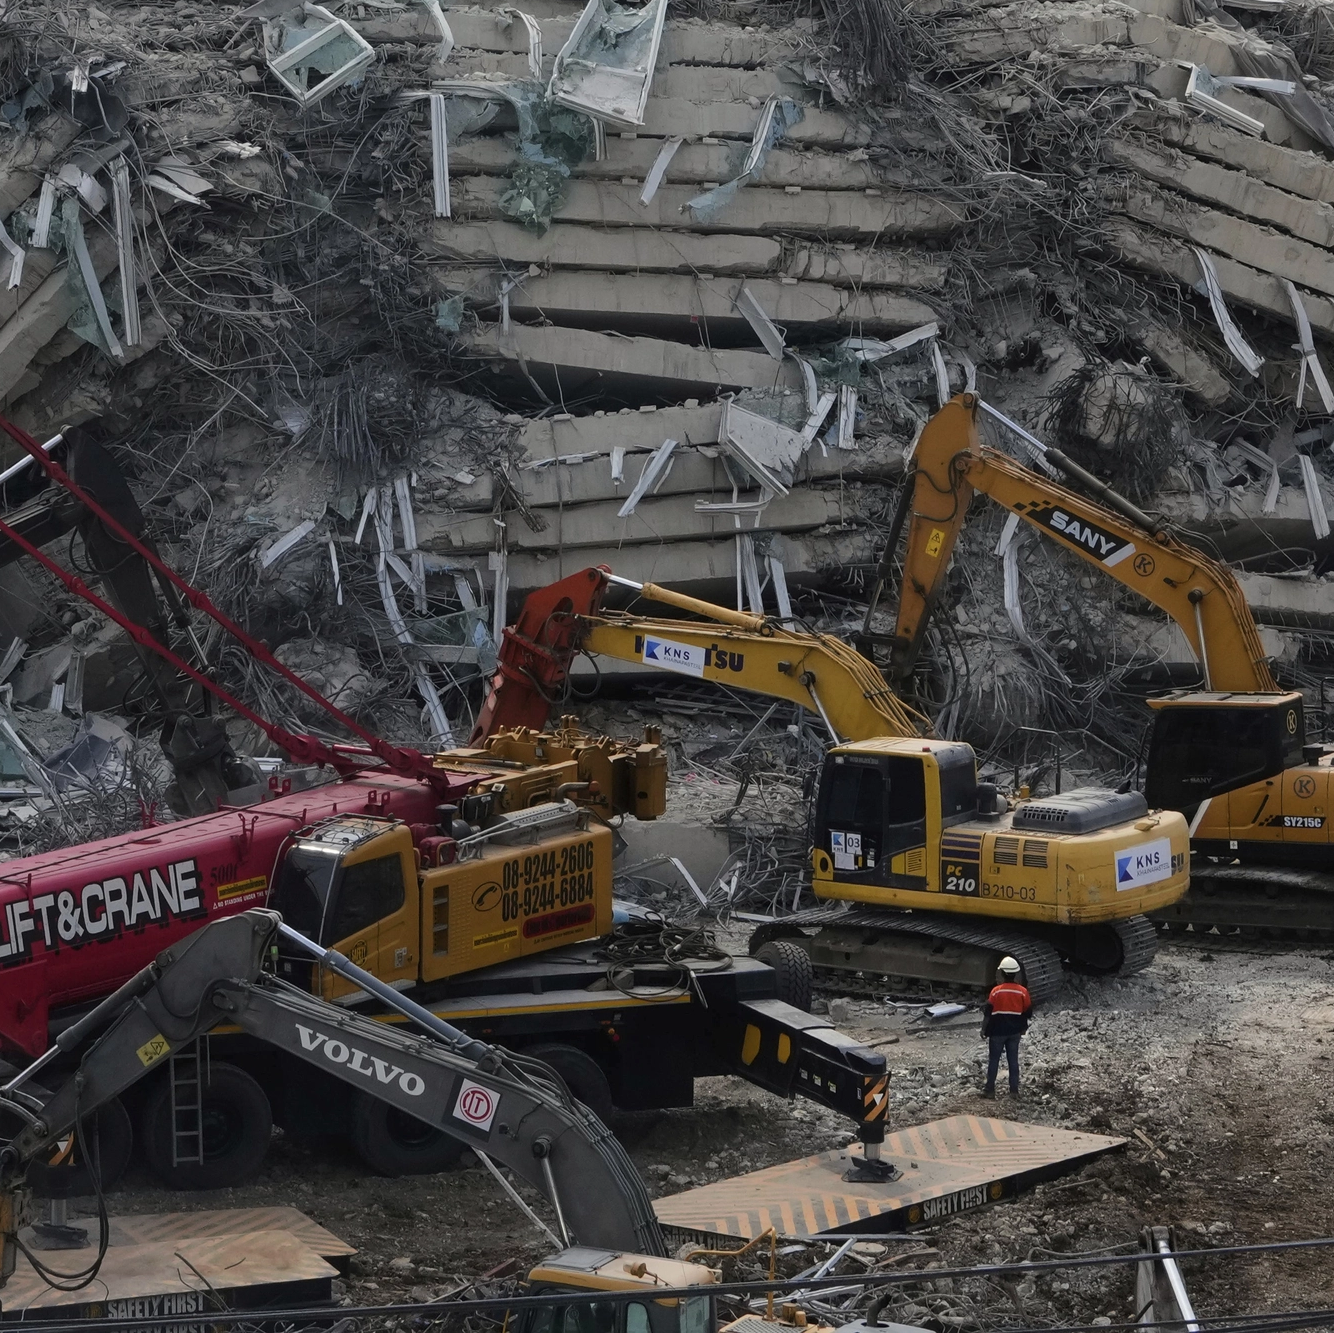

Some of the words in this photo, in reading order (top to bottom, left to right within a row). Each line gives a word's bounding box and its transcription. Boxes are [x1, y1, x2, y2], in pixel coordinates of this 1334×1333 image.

[1049, 510, 1116, 555] SANY
[663, 646, 691, 661] KNS
[1284, 816, 1322, 828] SY215C
[847, 837, 860, 848] 03
[502, 841, 594, 891] 08-9244-2606
[946, 864, 963, 877] PC
[1136, 851, 1160, 869] KNS
[946, 876, 976, 892] 210
[501, 871, 594, 922] 08-9244-6884
[295, 1023, 426, 1097] VOLVO
[923, 1193, 959, 1221] SAFETY
[108, 1295, 163, 1318] SAFETY
[163, 1292, 205, 1315] FIRST
